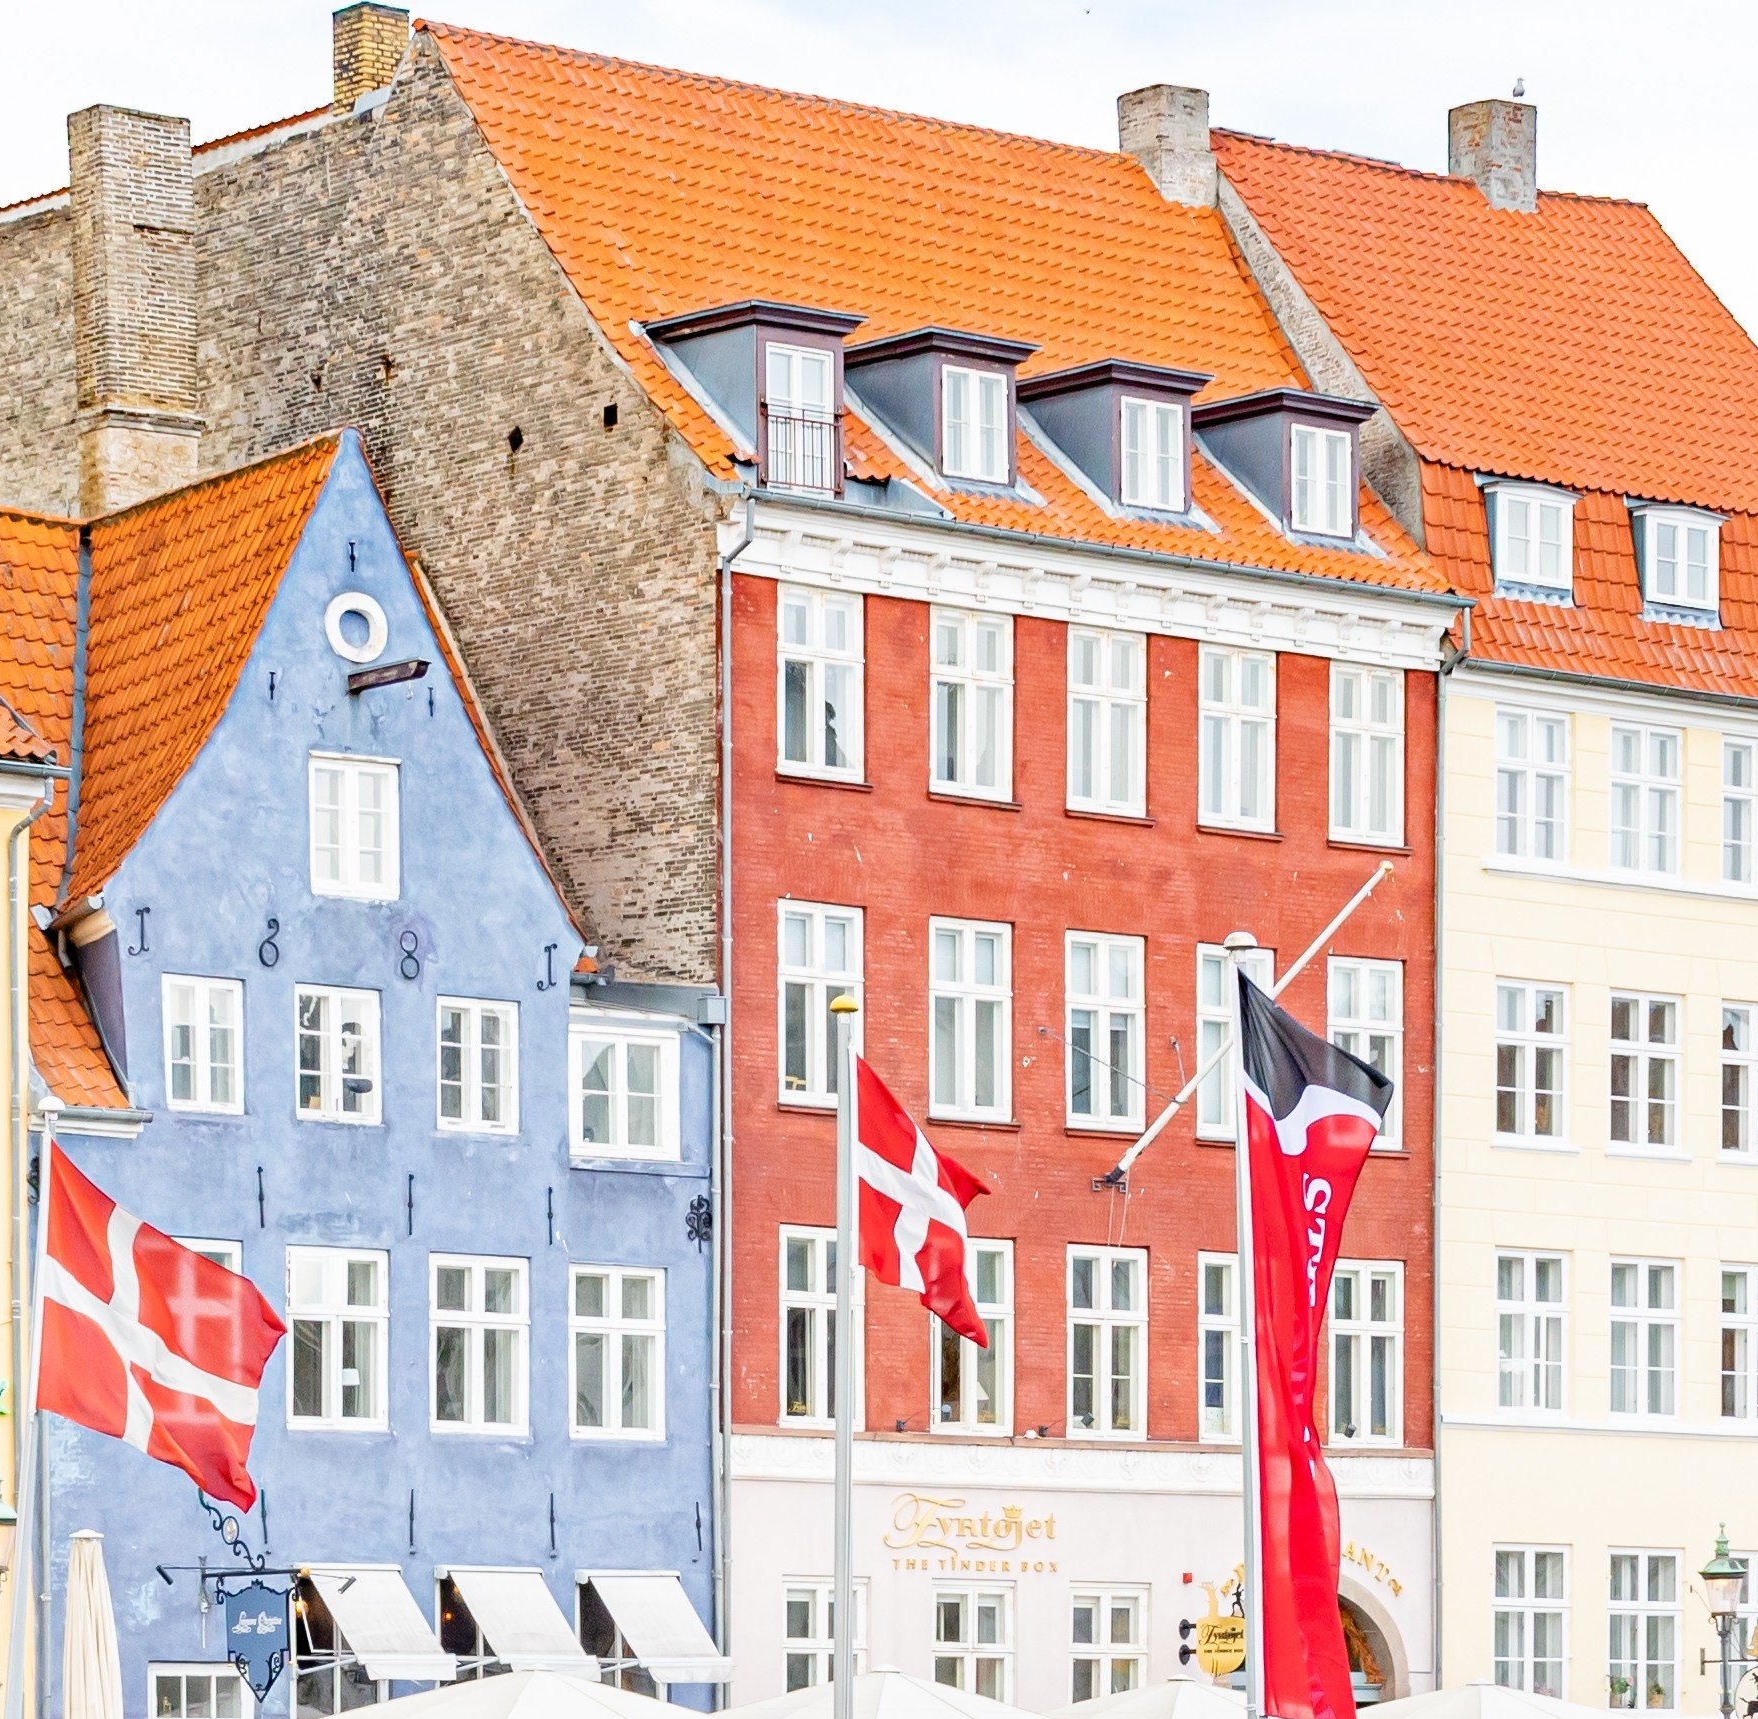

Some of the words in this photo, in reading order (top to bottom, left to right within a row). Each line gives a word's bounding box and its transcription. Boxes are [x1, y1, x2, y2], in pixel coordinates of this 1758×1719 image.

[892, 1558, 929, 1571] THE
[938, 1556, 1011, 1573] TINDER
[1021, 1561, 1058, 1574] BOX
